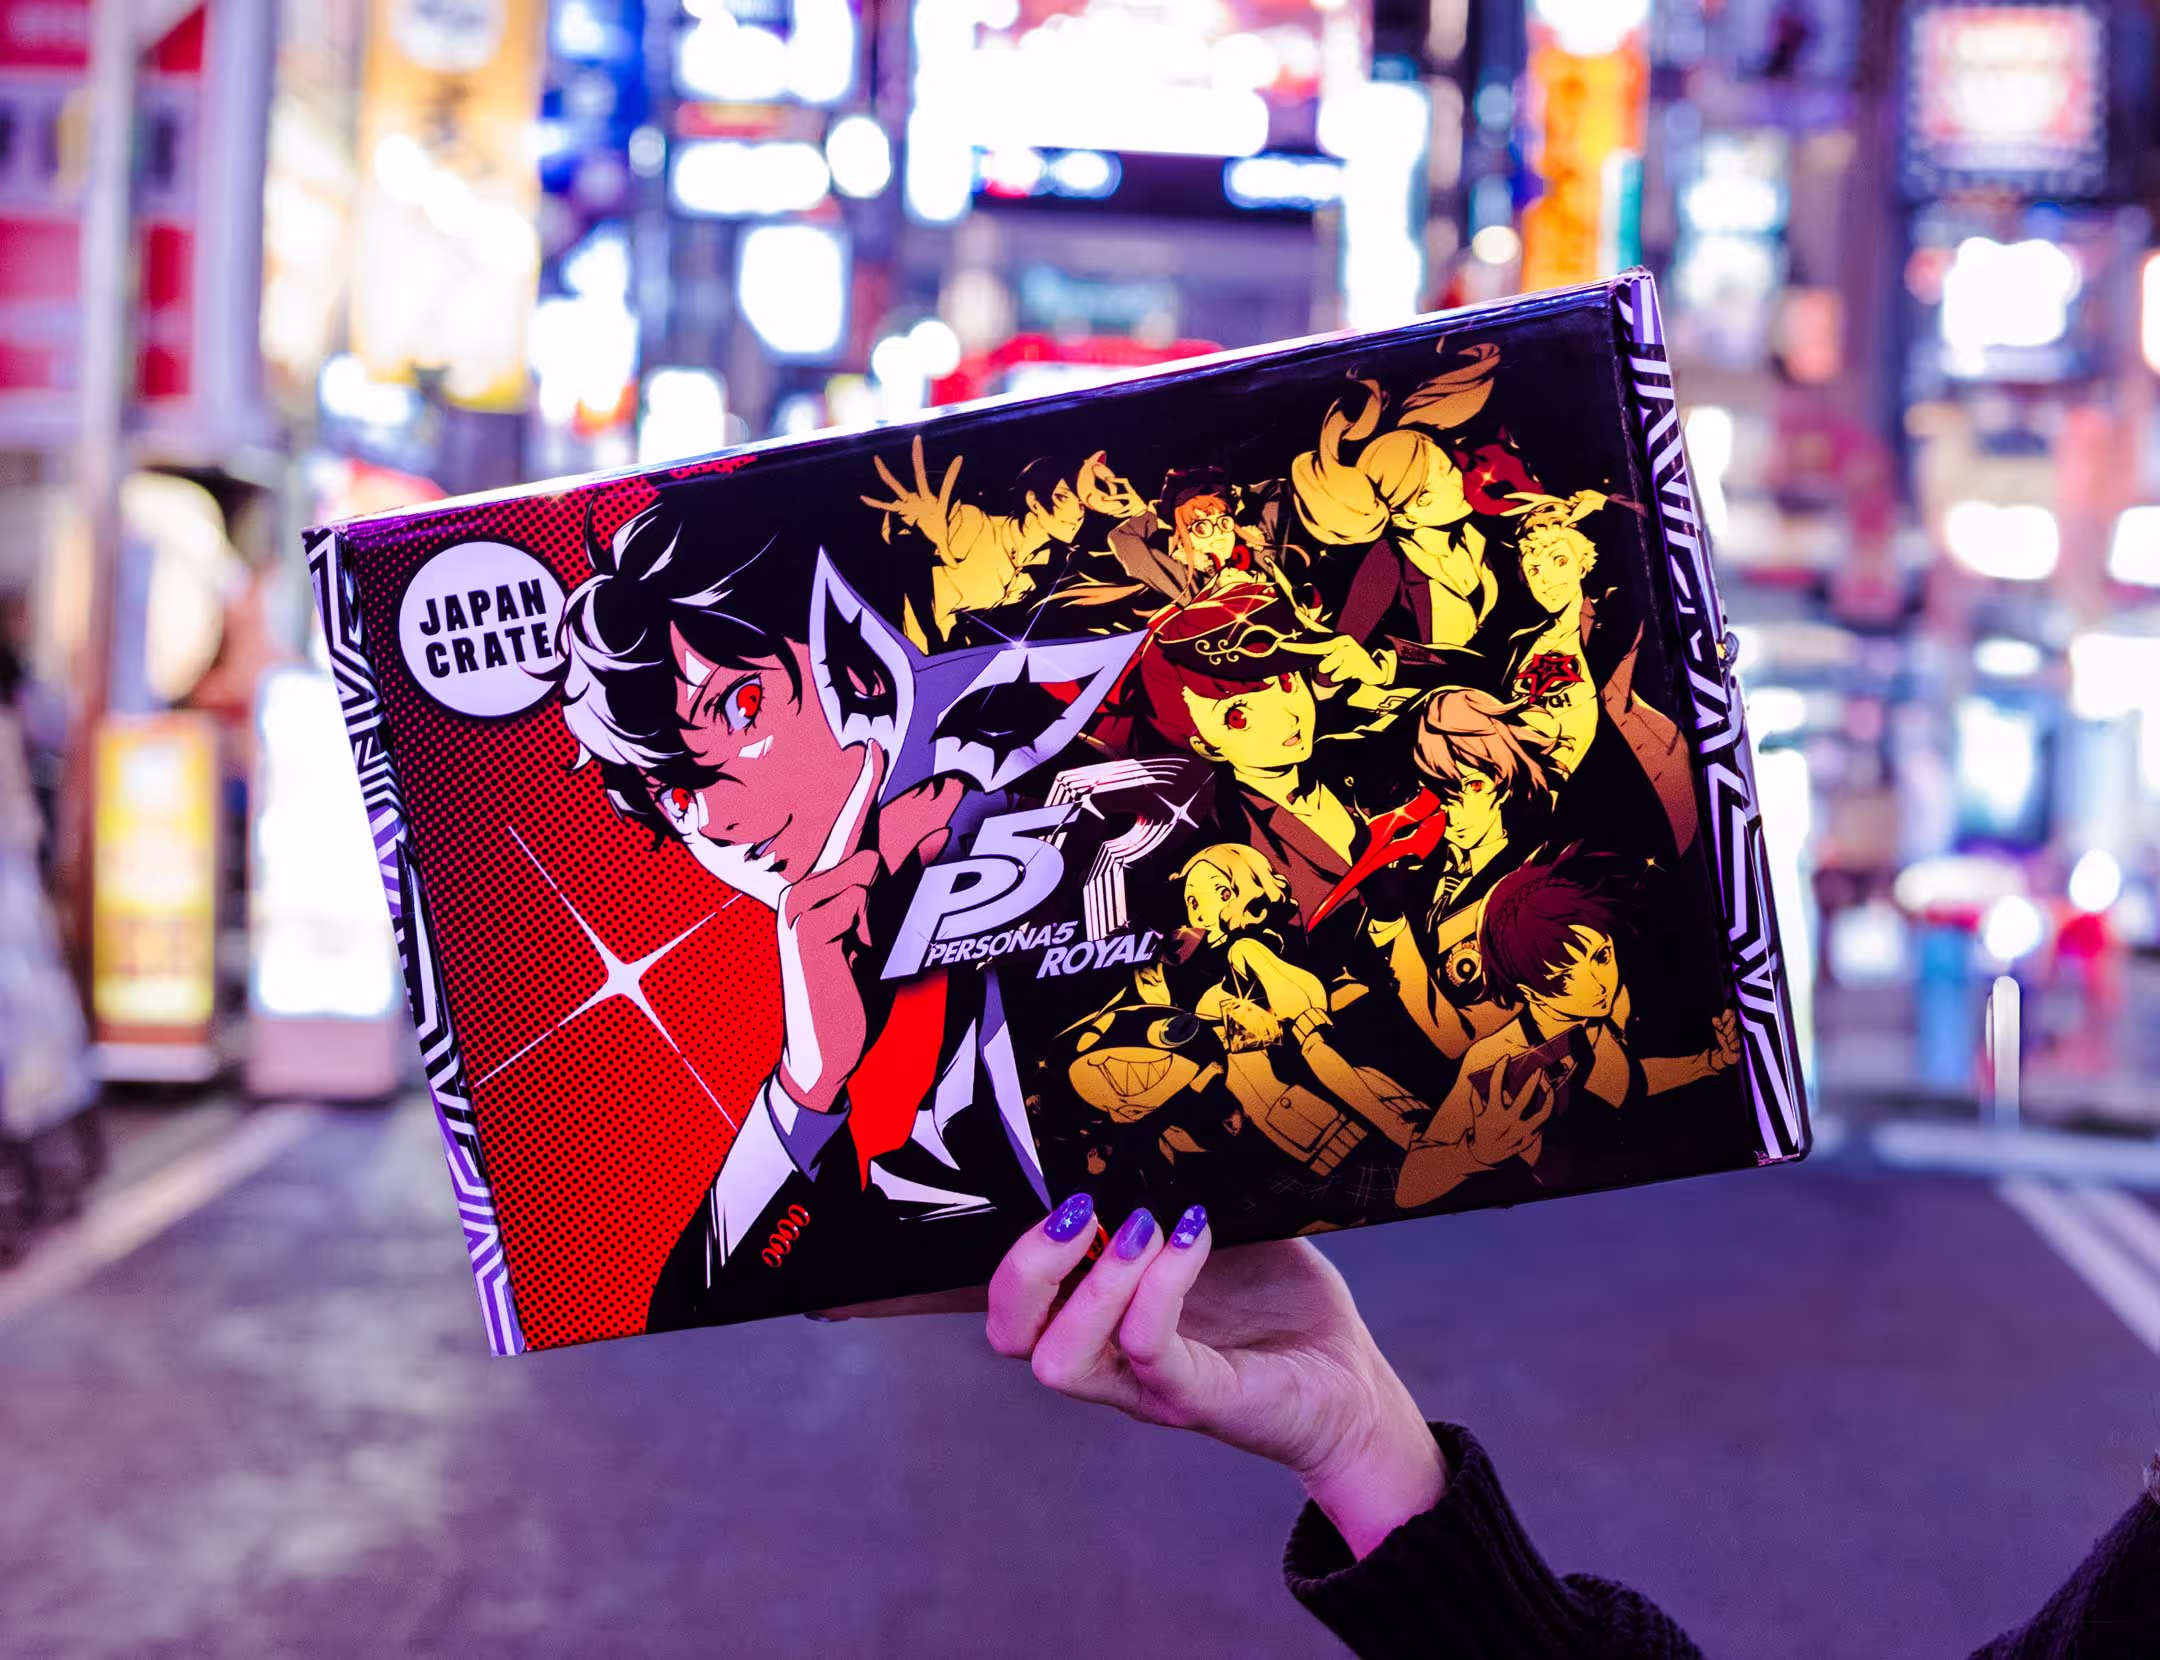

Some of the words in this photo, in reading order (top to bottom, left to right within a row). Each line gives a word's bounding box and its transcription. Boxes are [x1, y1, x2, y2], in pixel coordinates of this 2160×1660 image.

[419, 578, 547, 636] JAPAN
[425, 621, 553, 678] CRATE
[1036, 930, 1156, 979] ROYAL
